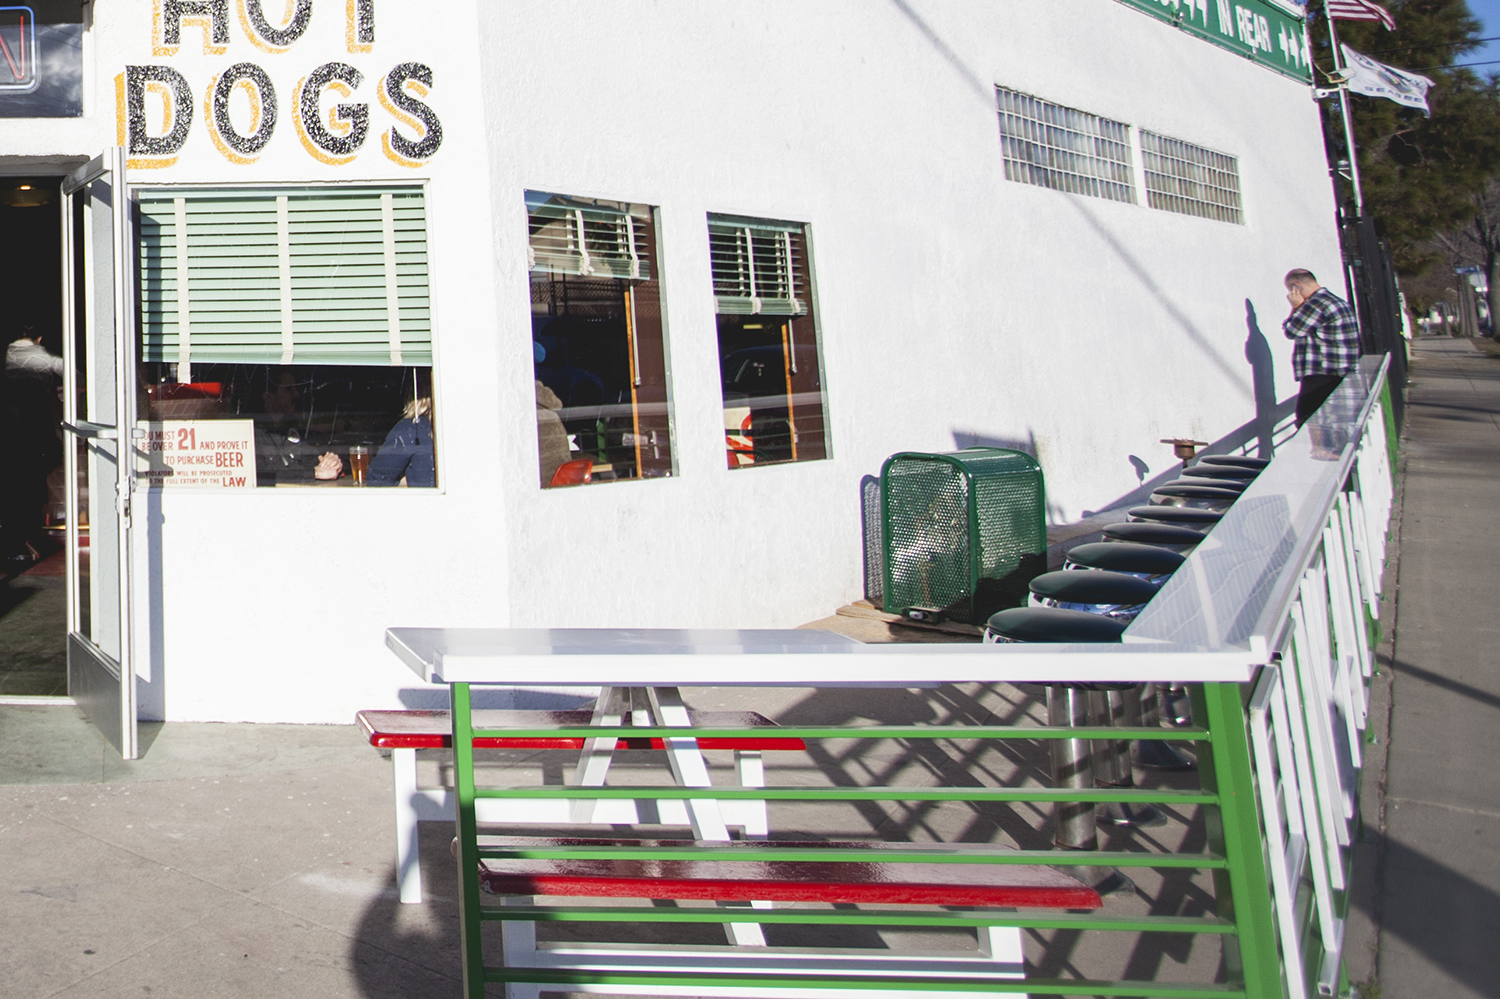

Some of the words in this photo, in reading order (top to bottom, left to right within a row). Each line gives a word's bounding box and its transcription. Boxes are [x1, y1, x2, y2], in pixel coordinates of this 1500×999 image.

[1235, 4, 1272, 54] REAR
[114, 61, 443, 170] DOGS
[141, 442, 151, 452] BE
[152, 441, 174, 452] OVER
[177, 427, 196, 451] 21
[200, 441, 215, 450] AND
[217, 441, 240, 450] PROVE
[241, 441, 249, 450] IT
[155, 431, 175, 441] MUST
[165, 455, 175, 465] TO
[177, 455, 214, 465] PURCHASE
[215, 452, 244, 468] BEER
[222, 477, 247, 487] LAW
